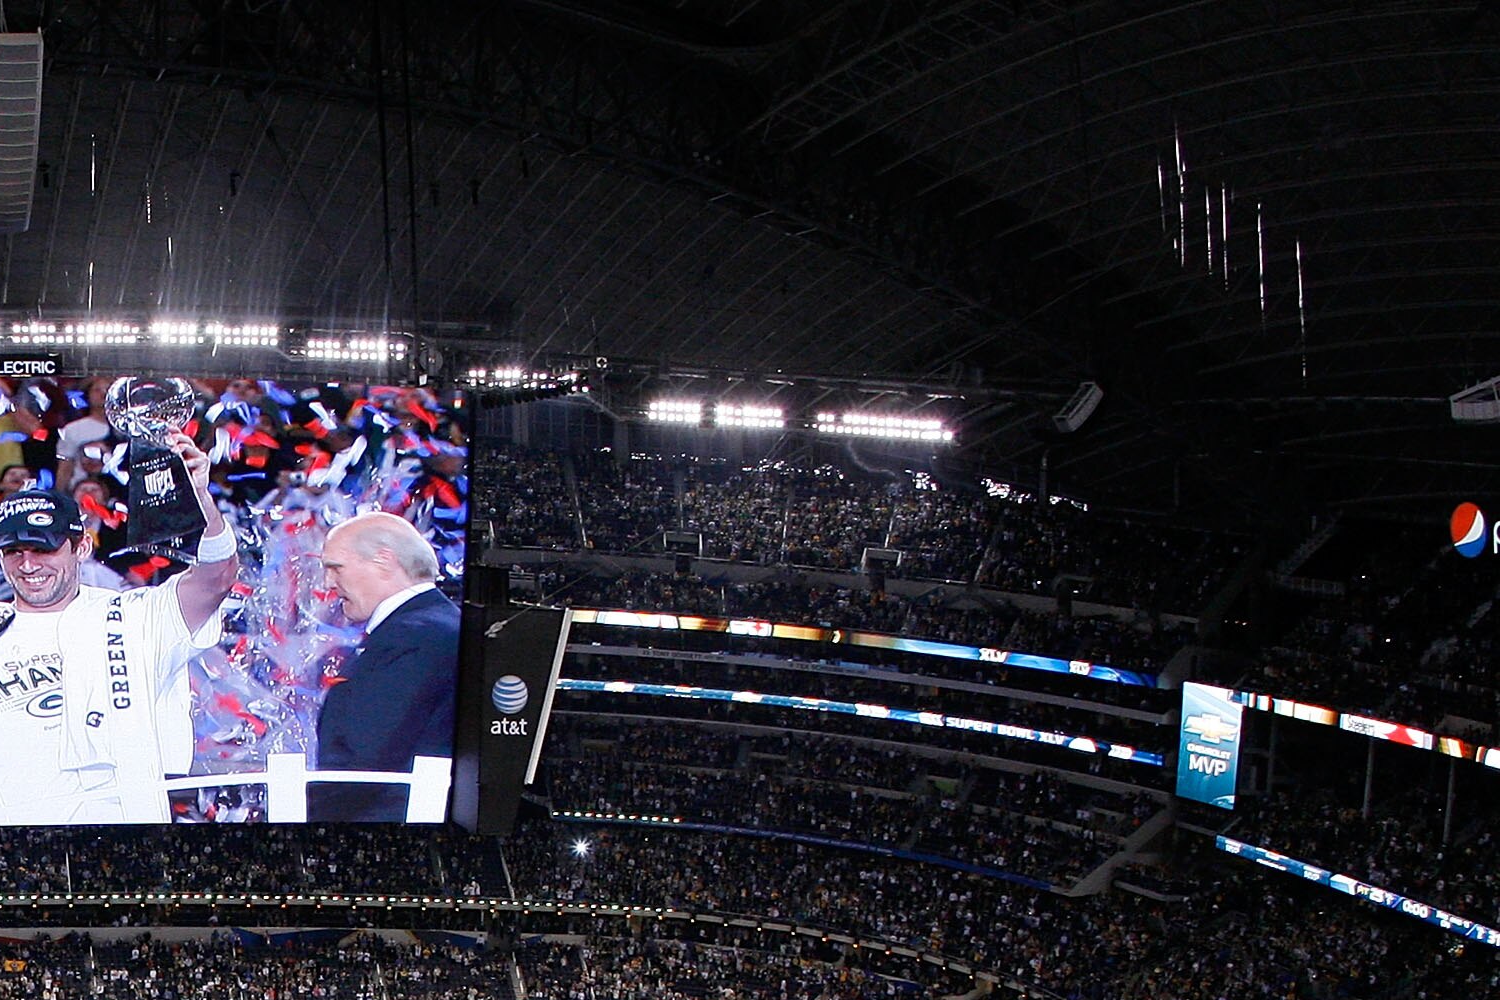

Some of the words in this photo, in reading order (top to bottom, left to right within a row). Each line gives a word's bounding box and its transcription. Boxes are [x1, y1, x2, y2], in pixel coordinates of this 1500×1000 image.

[27, 513, 53, 527] G
[978, 648, 1008, 663] XLV
[109, 631, 131, 710] GREEN
[490, 717, 528, 735] at&t
[945, 717, 993, 733] SUPER
[997, 723, 1035, 740] BOWL
[1038, 731, 1067, 745] XLV
[1188, 754, 1227, 776] MVP
